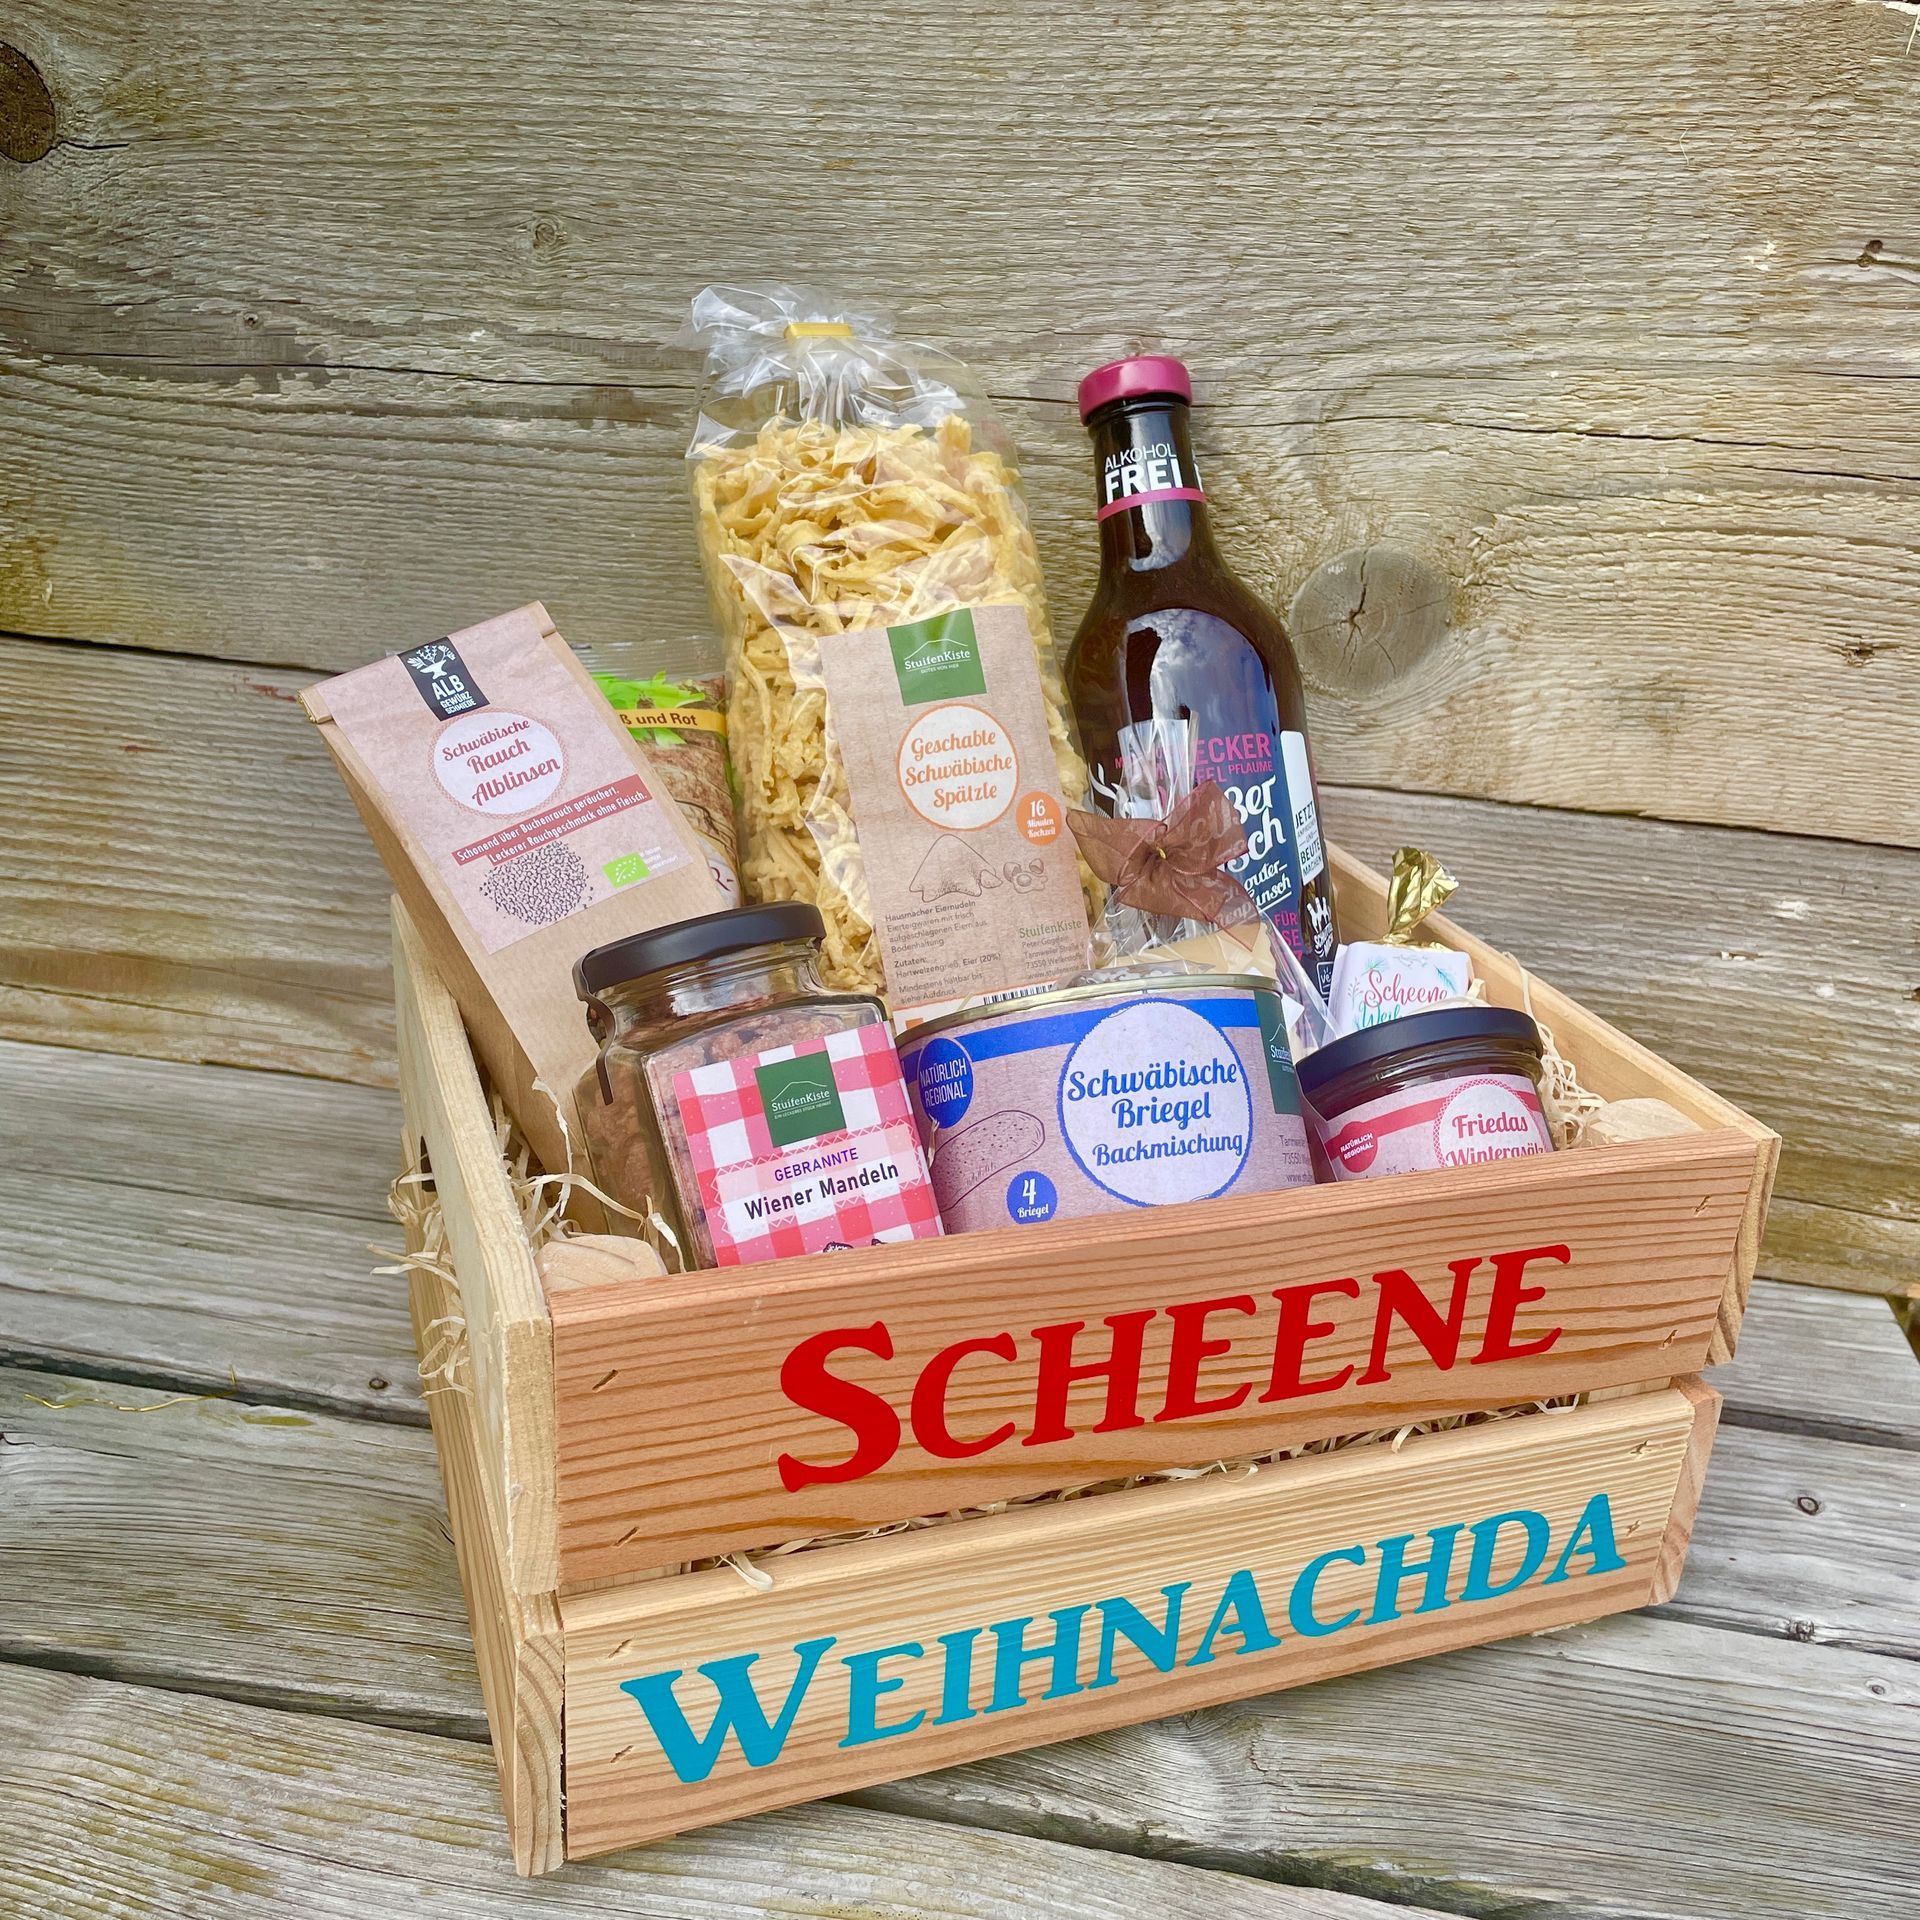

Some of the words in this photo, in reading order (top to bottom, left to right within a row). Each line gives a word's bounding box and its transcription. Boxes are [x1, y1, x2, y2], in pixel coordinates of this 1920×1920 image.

[1105, 443, 1177, 473] ALKOHOL
[1105, 459, 1183, 504] FREI
[904, 649, 971, 670] StuifenKiste
[432, 674, 465, 700] ALB
[440, 691, 473, 709] GEWÜRZ
[636, 712, 667, 725] und
[669, 712, 699, 726] Rot
[442, 720, 530, 761] Schwäbische
[911, 730, 996, 761] Geschabte
[1196, 733, 1272, 767] ECKER
[467, 738, 531, 774] Rauch
[1228, 761, 1273, 775] PFLAUME
[472, 758, 561, 806] Alblinsen
[905, 754, 1012, 787] Schwäbische
[933, 782, 997, 811] Spätzle
[1030, 799, 1046, 818] 16
[456, 836, 500, 861] Schonend
[499, 828, 520, 843] über
[519, 805, 574, 833] Buchenrauch
[573, 786, 620, 812] geräuchert.
[488, 839, 527, 864] Leckerer
[528, 812, 596, 847] Rauchgeschmack
[596, 803, 618, 817] ohne
[616, 791, 648, 809] Fleisch.
[1300, 841, 1321, 864] BEUTE
[885, 907, 934, 923] Hausmacher
[934, 899, 976, 913] Eiernudeln
[1273, 912, 1298, 926] FÜR
[1018, 920, 1082, 939] StuifenKiste
[891, 938, 945, 953] Bodenhaltung
[962, 957, 978, 967] Eier
[979, 952, 1002, 965] (20%)
[894, 956, 928, 969] Zutaten:
[898, 979, 943, 994] Mindestens
[1364, 970, 1449, 1008] Scheene
[919, 1057, 968, 1088] NATÜRLICH
[1067, 1058, 1238, 1101] Schwäbische
[771, 1089, 831, 1112] StuifenKiste
[924, 1080, 968, 1108] REGIONAL
[1112, 1098, 1211, 1130] Briegel
[1452, 1111, 1529, 1138] Friedas
[1092, 1132, 1244, 1166] Backmischung
[1340, 1133, 1374, 1152] NATÜRLICH
[1344, 1142, 1375, 1161] REGIONAL
[774, 1147, 860, 1182] GEBRANNTE
[744, 1187, 813, 1220] Wiener
[819, 1162, 900, 1198] Mandeln
[1022, 1178, 1037, 1206] 4
[1017, 1203, 1050, 1218] Briegel
[778, 1244, 1572, 1494] SCHEENE
[620, 1493, 1627, 1784] WEIHNACHDA
